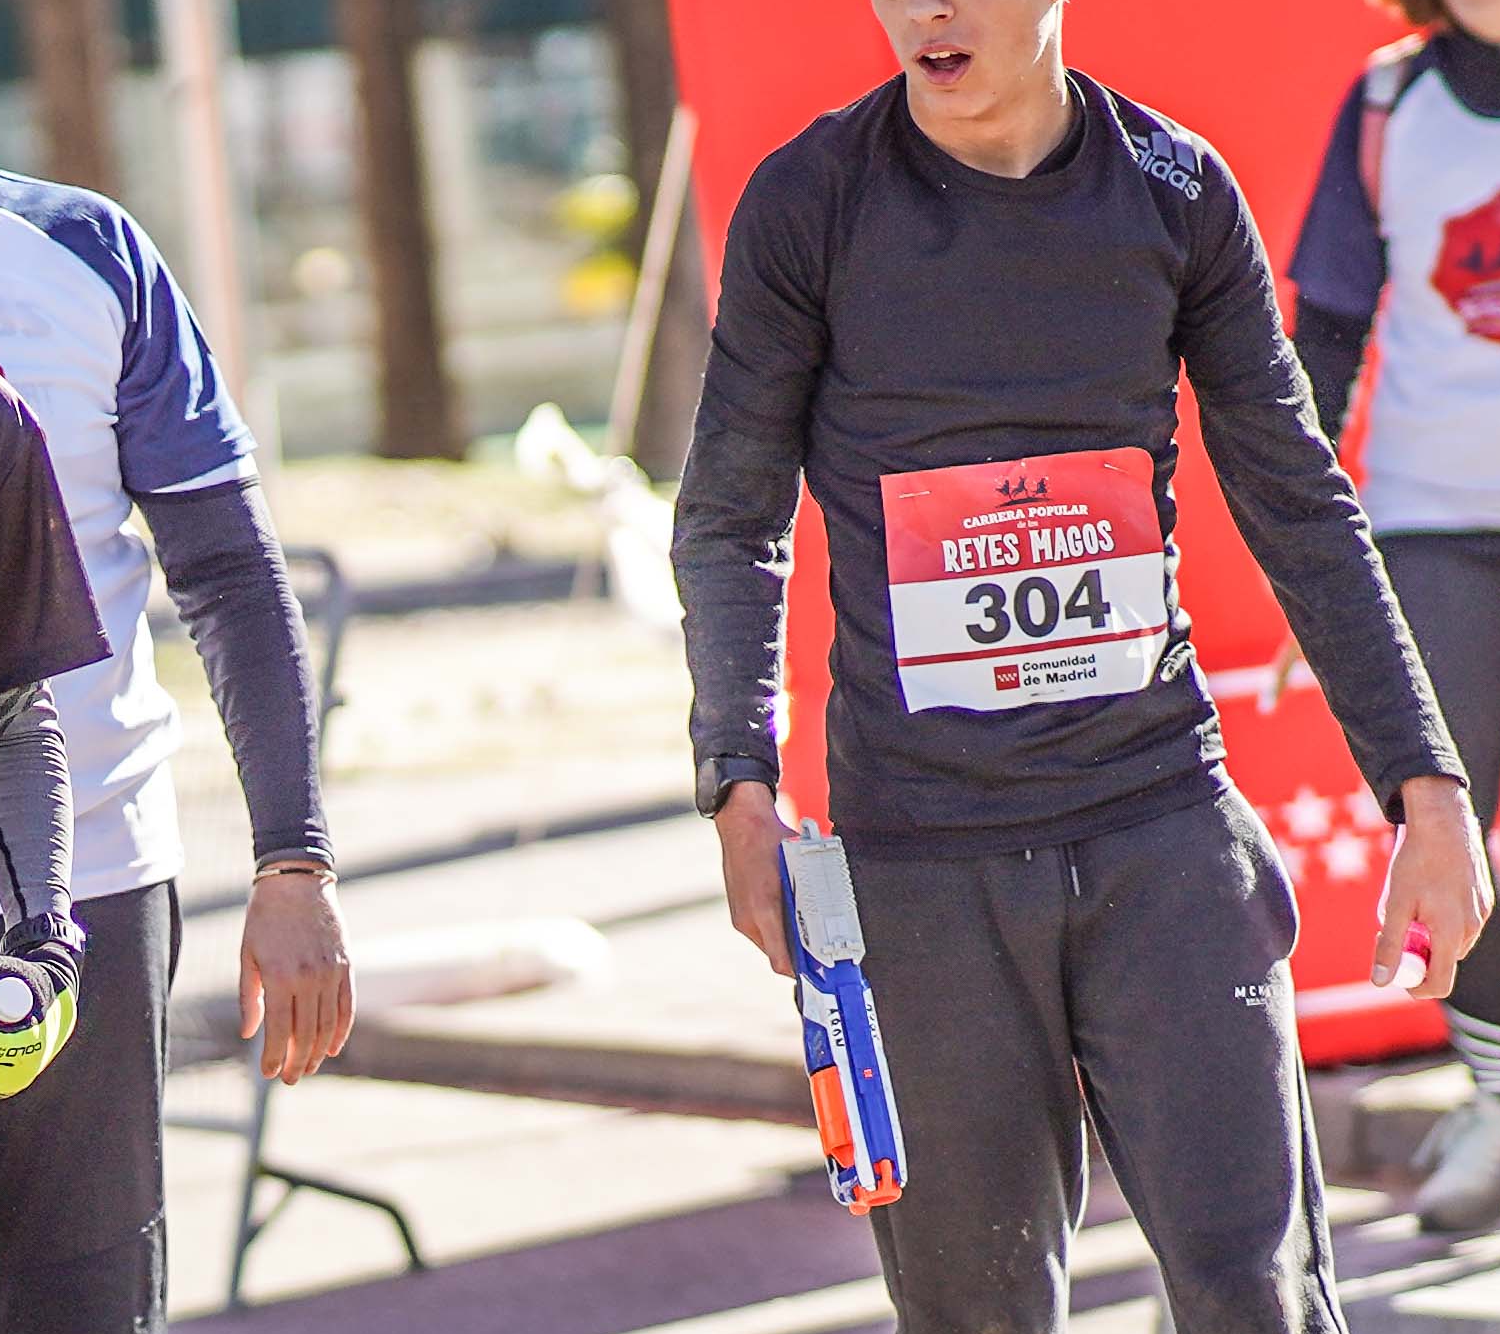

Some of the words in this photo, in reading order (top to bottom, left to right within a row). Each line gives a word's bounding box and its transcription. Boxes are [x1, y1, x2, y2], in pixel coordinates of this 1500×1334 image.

[1136, 149, 1202, 201] didas
[963, 509, 1026, 529] CARRERA
[1028, 504, 1088, 518] POPULAR
[942, 533, 1020, 573] REYES
[1029, 520, 1115, 564] MAGOS
[965, 569, 1111, 644] 304
[1022, 654, 1096, 672] Comunidad
[1023, 676, 1041, 686] de
[1046, 668, 1097, 684] Madrid
[6, 1042, 42, 1057] COLD
